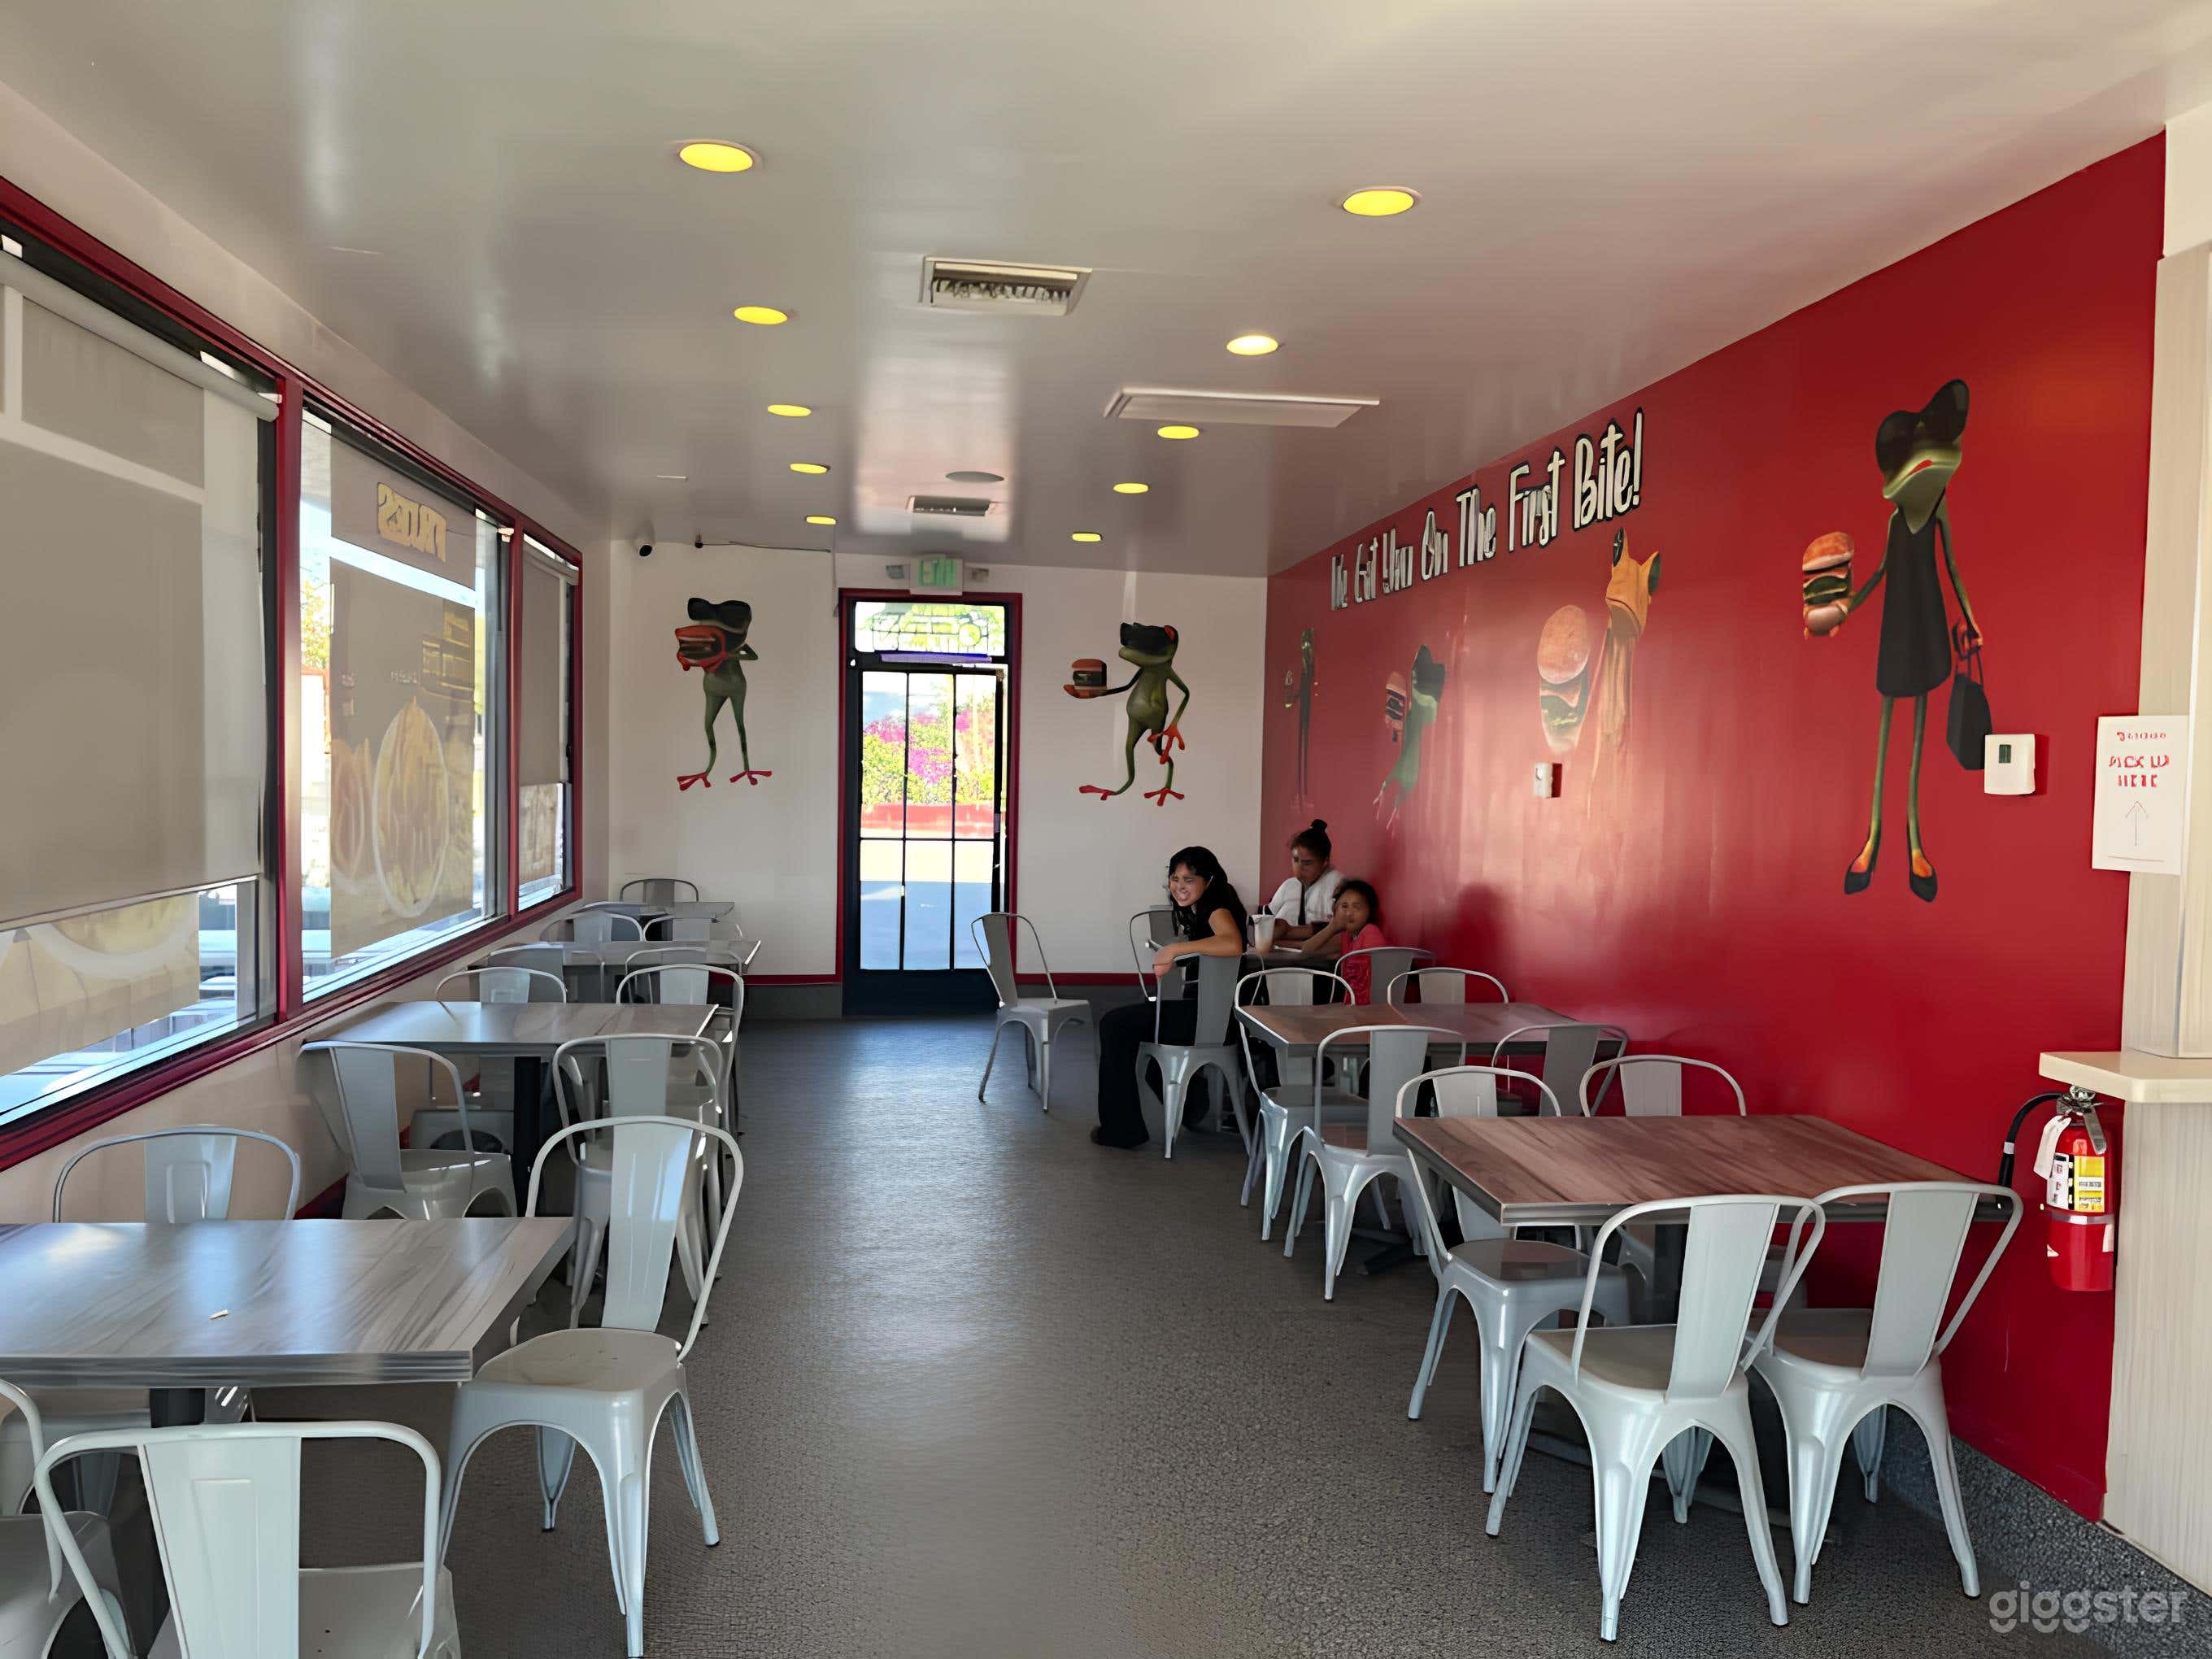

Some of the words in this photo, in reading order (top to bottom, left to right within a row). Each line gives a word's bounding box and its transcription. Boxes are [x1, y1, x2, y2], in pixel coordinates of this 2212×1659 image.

[1456, 485, 1497, 568] The
[1509, 446, 1566, 553] First
[1573, 407, 1644, 531] Bite!
